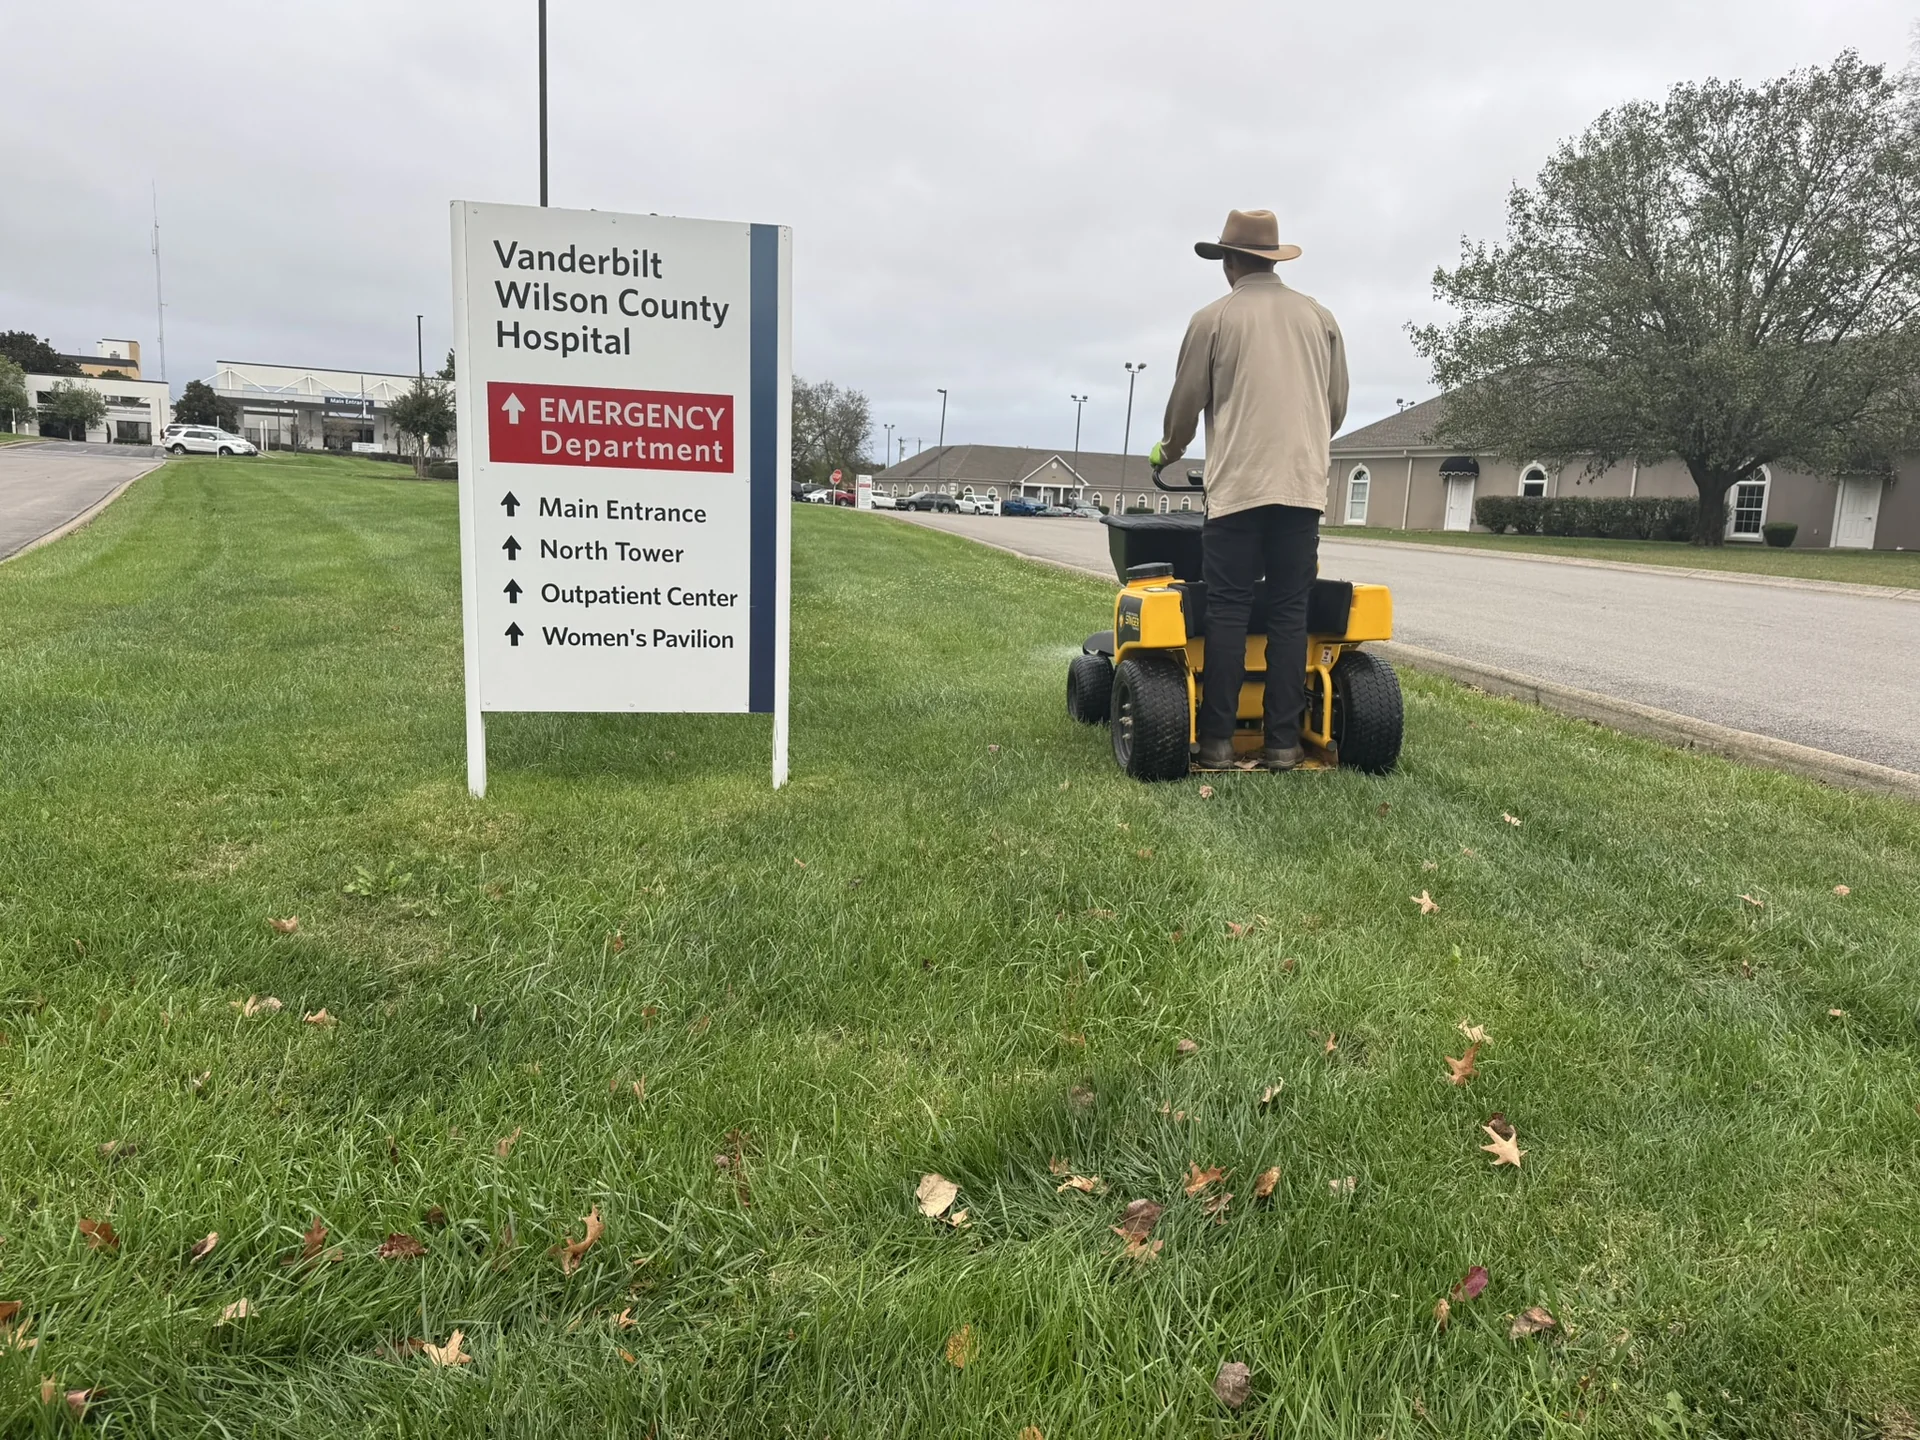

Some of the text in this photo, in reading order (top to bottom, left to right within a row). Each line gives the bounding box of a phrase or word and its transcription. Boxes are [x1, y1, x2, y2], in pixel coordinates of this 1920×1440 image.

[493, 240, 663, 279] Vanderbilt
[494, 281, 730, 329] Wilson County
[496, 320, 631, 358] Hospital
[540, 397, 726, 432] EMERGENCY
[541, 430, 724, 464] Department
[539, 497, 707, 524] Main Entrance
[540, 539, 685, 564] North Tower
[541, 583, 738, 609] Outpatient Center
[541, 626, 734, 649] Women's Pavilion
